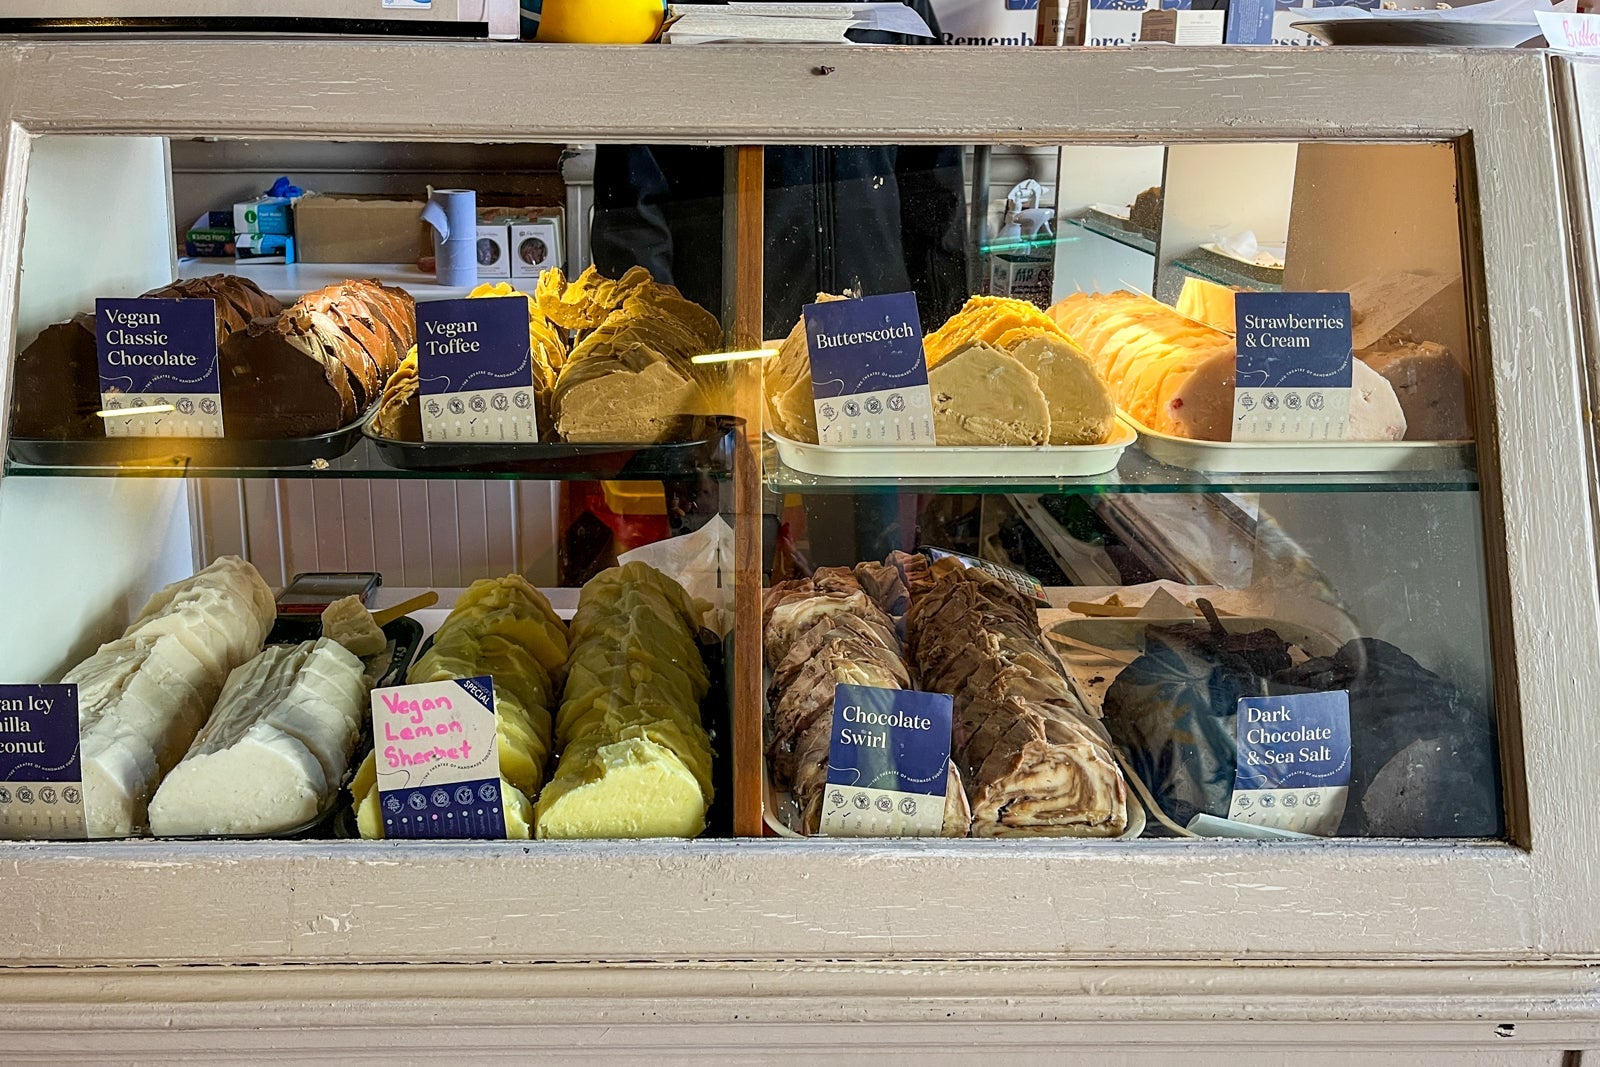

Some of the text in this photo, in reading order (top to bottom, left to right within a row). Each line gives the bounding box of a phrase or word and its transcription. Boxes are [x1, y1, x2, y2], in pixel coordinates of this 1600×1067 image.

[105, 309, 160, 328] Vegan
[1245, 314, 1344, 329] Strawberries
[106, 330, 168, 345] Classic
[425, 321, 478, 337] Vegan
[816, 323, 914, 349] Butterscotch
[426, 339, 480, 356] Toffee
[1245, 333, 1310, 347] & Cream
[108, 351, 197, 366] Chocolate
[463, 680, 490, 706] SPECIAL
[0, 696, 54, 714] an Icy
[381, 692, 453, 724] Vegan
[1248, 706, 1292, 723] Dark
[843, 706, 931, 730] Chocolate
[385, 721, 463, 742] Lemon
[840, 728, 886, 749] Swirl
[1247, 725, 1332, 744] Chocolate
[1247, 746, 1332, 766] & Sea Salt
